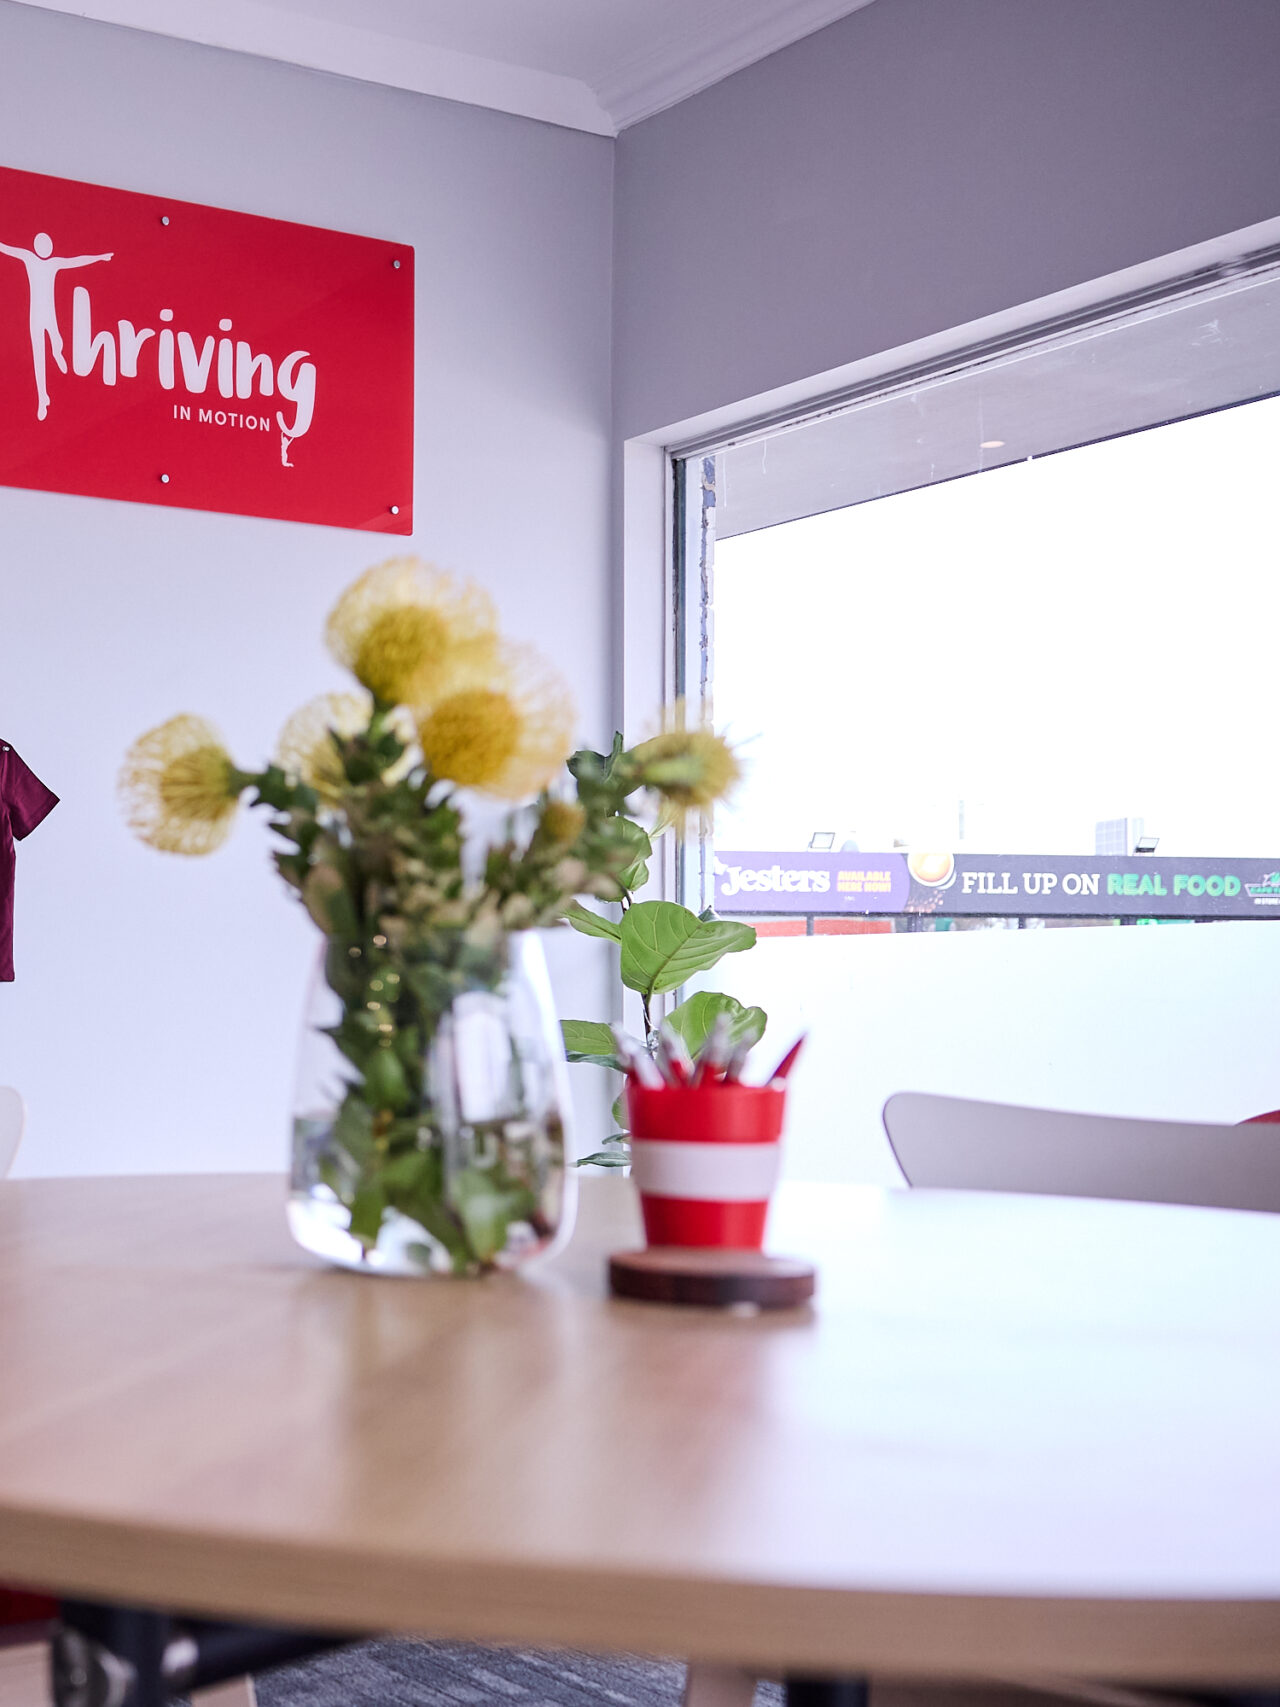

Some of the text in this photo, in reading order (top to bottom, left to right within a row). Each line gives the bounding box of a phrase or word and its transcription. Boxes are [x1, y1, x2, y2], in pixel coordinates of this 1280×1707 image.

[173, 404, 271, 433] IN MOTION
[721, 865, 831, 896] Jesters
[837, 871, 891, 882] AVAILABLE
[837, 881, 863, 892] HERE
[961, 872, 1242, 897] FILL UP ON REAL FOOD
